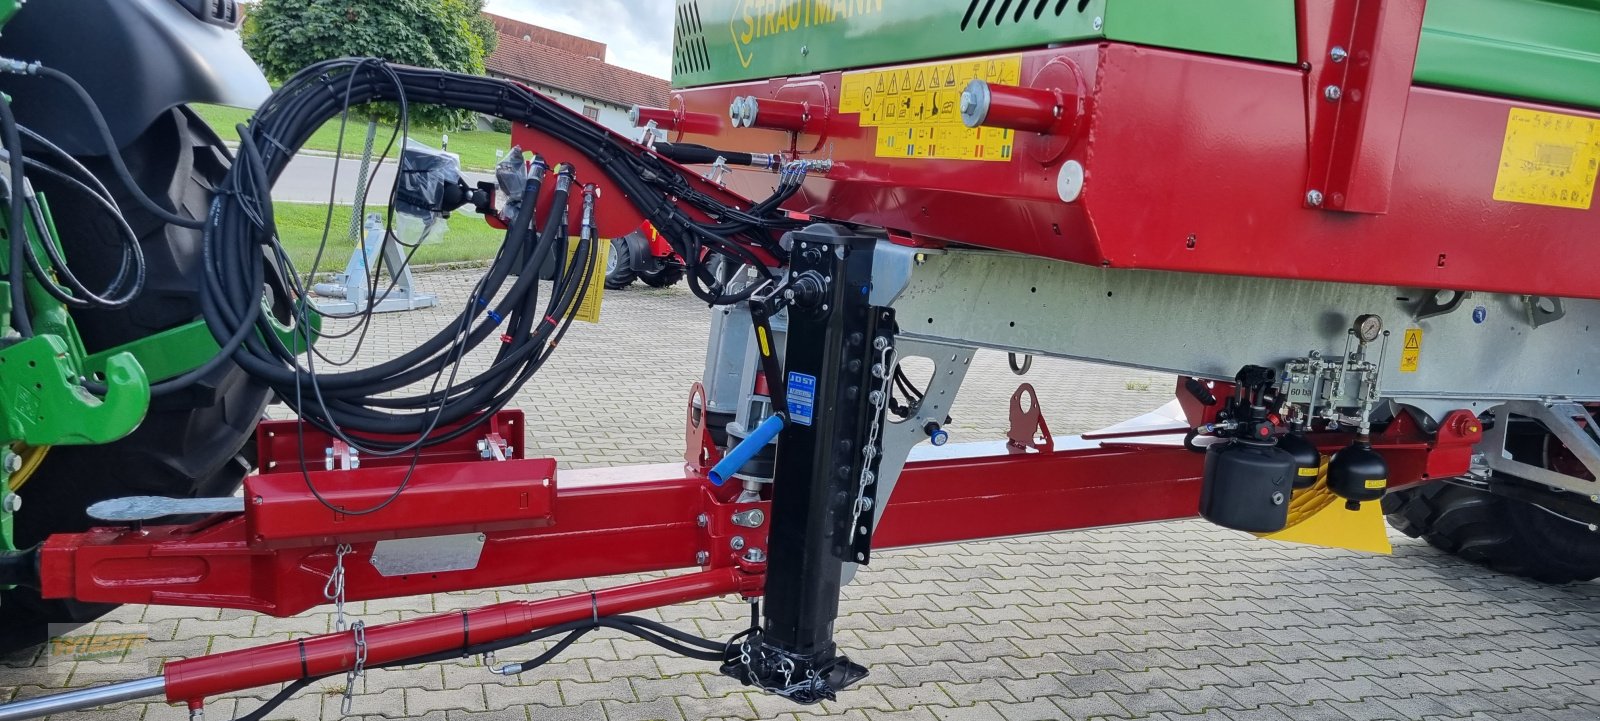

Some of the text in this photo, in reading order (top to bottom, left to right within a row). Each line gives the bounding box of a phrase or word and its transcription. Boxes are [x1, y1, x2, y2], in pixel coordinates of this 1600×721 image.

[789, 374, 815, 386] JOST
[1290, 388, 1312, 396] 60 ba
